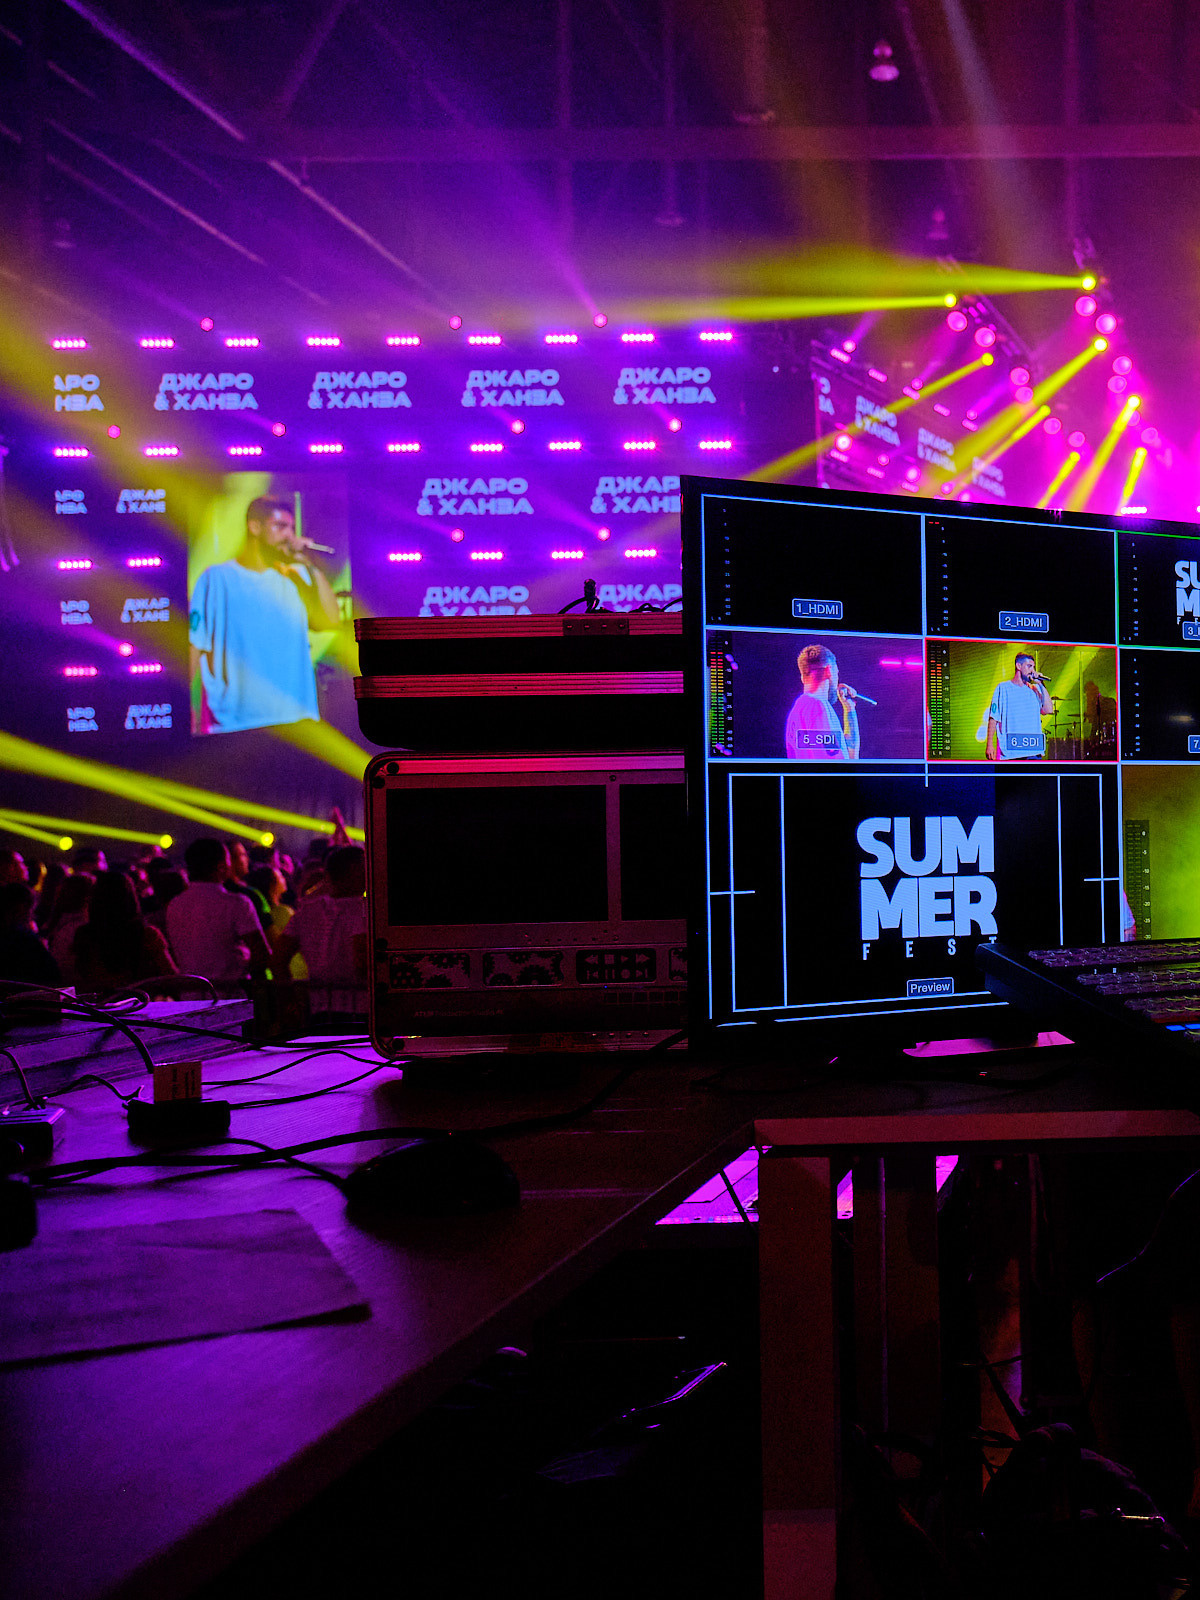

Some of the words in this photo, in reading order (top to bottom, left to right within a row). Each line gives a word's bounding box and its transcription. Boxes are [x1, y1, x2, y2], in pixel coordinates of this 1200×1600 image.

[159, 373, 254, 393] ДЖАРО
[313, 371, 407, 392] ДЖАРО
[466, 369, 560, 389] ДЖАРО
[618, 367, 712, 387] ДЖАРО
[154, 392, 169, 411] &
[308, 391, 323, 409] &
[461, 388, 476, 407] &
[613, 387, 628, 405] &
[421, 477, 529, 499] ДЖАРО
[416, 498, 433, 516] &
[590, 496, 608, 514] &
[423, 585, 530, 607] ДЖАРО
[796, 602, 839, 615] 1_HDMI
[1004, 616, 1043, 628] 2_HDMI
[803, 734, 835, 746] 5_SDI
[1011, 737, 1039, 748] 6_SDI
[856, 815, 995, 878] SUM
[860, 875, 998, 940] MER
[910, 981, 951, 994] Preview
